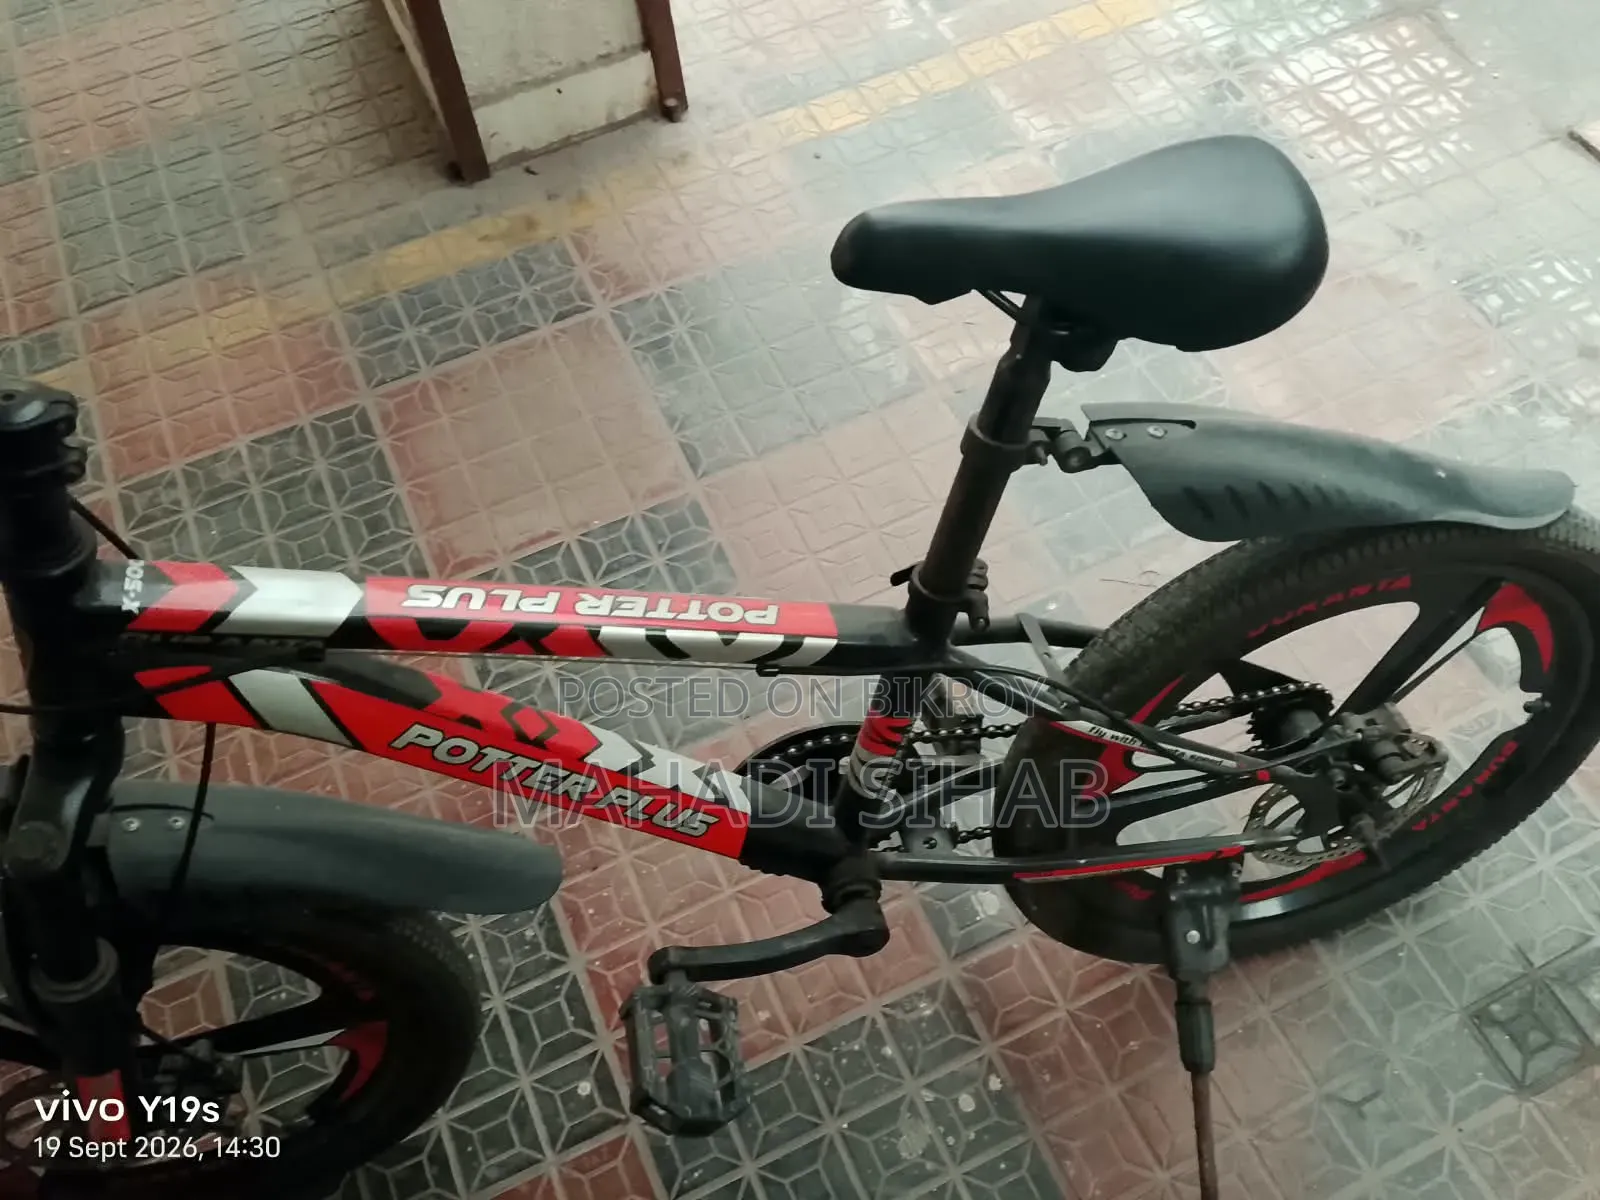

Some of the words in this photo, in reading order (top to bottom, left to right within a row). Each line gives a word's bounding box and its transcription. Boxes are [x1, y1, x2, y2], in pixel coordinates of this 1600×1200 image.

[401, 584, 562, 614] PLUS
[574, 592, 779, 625] POTTER
[390, 723, 600, 803] POTTER
[590, 785, 720, 838] PLUS
